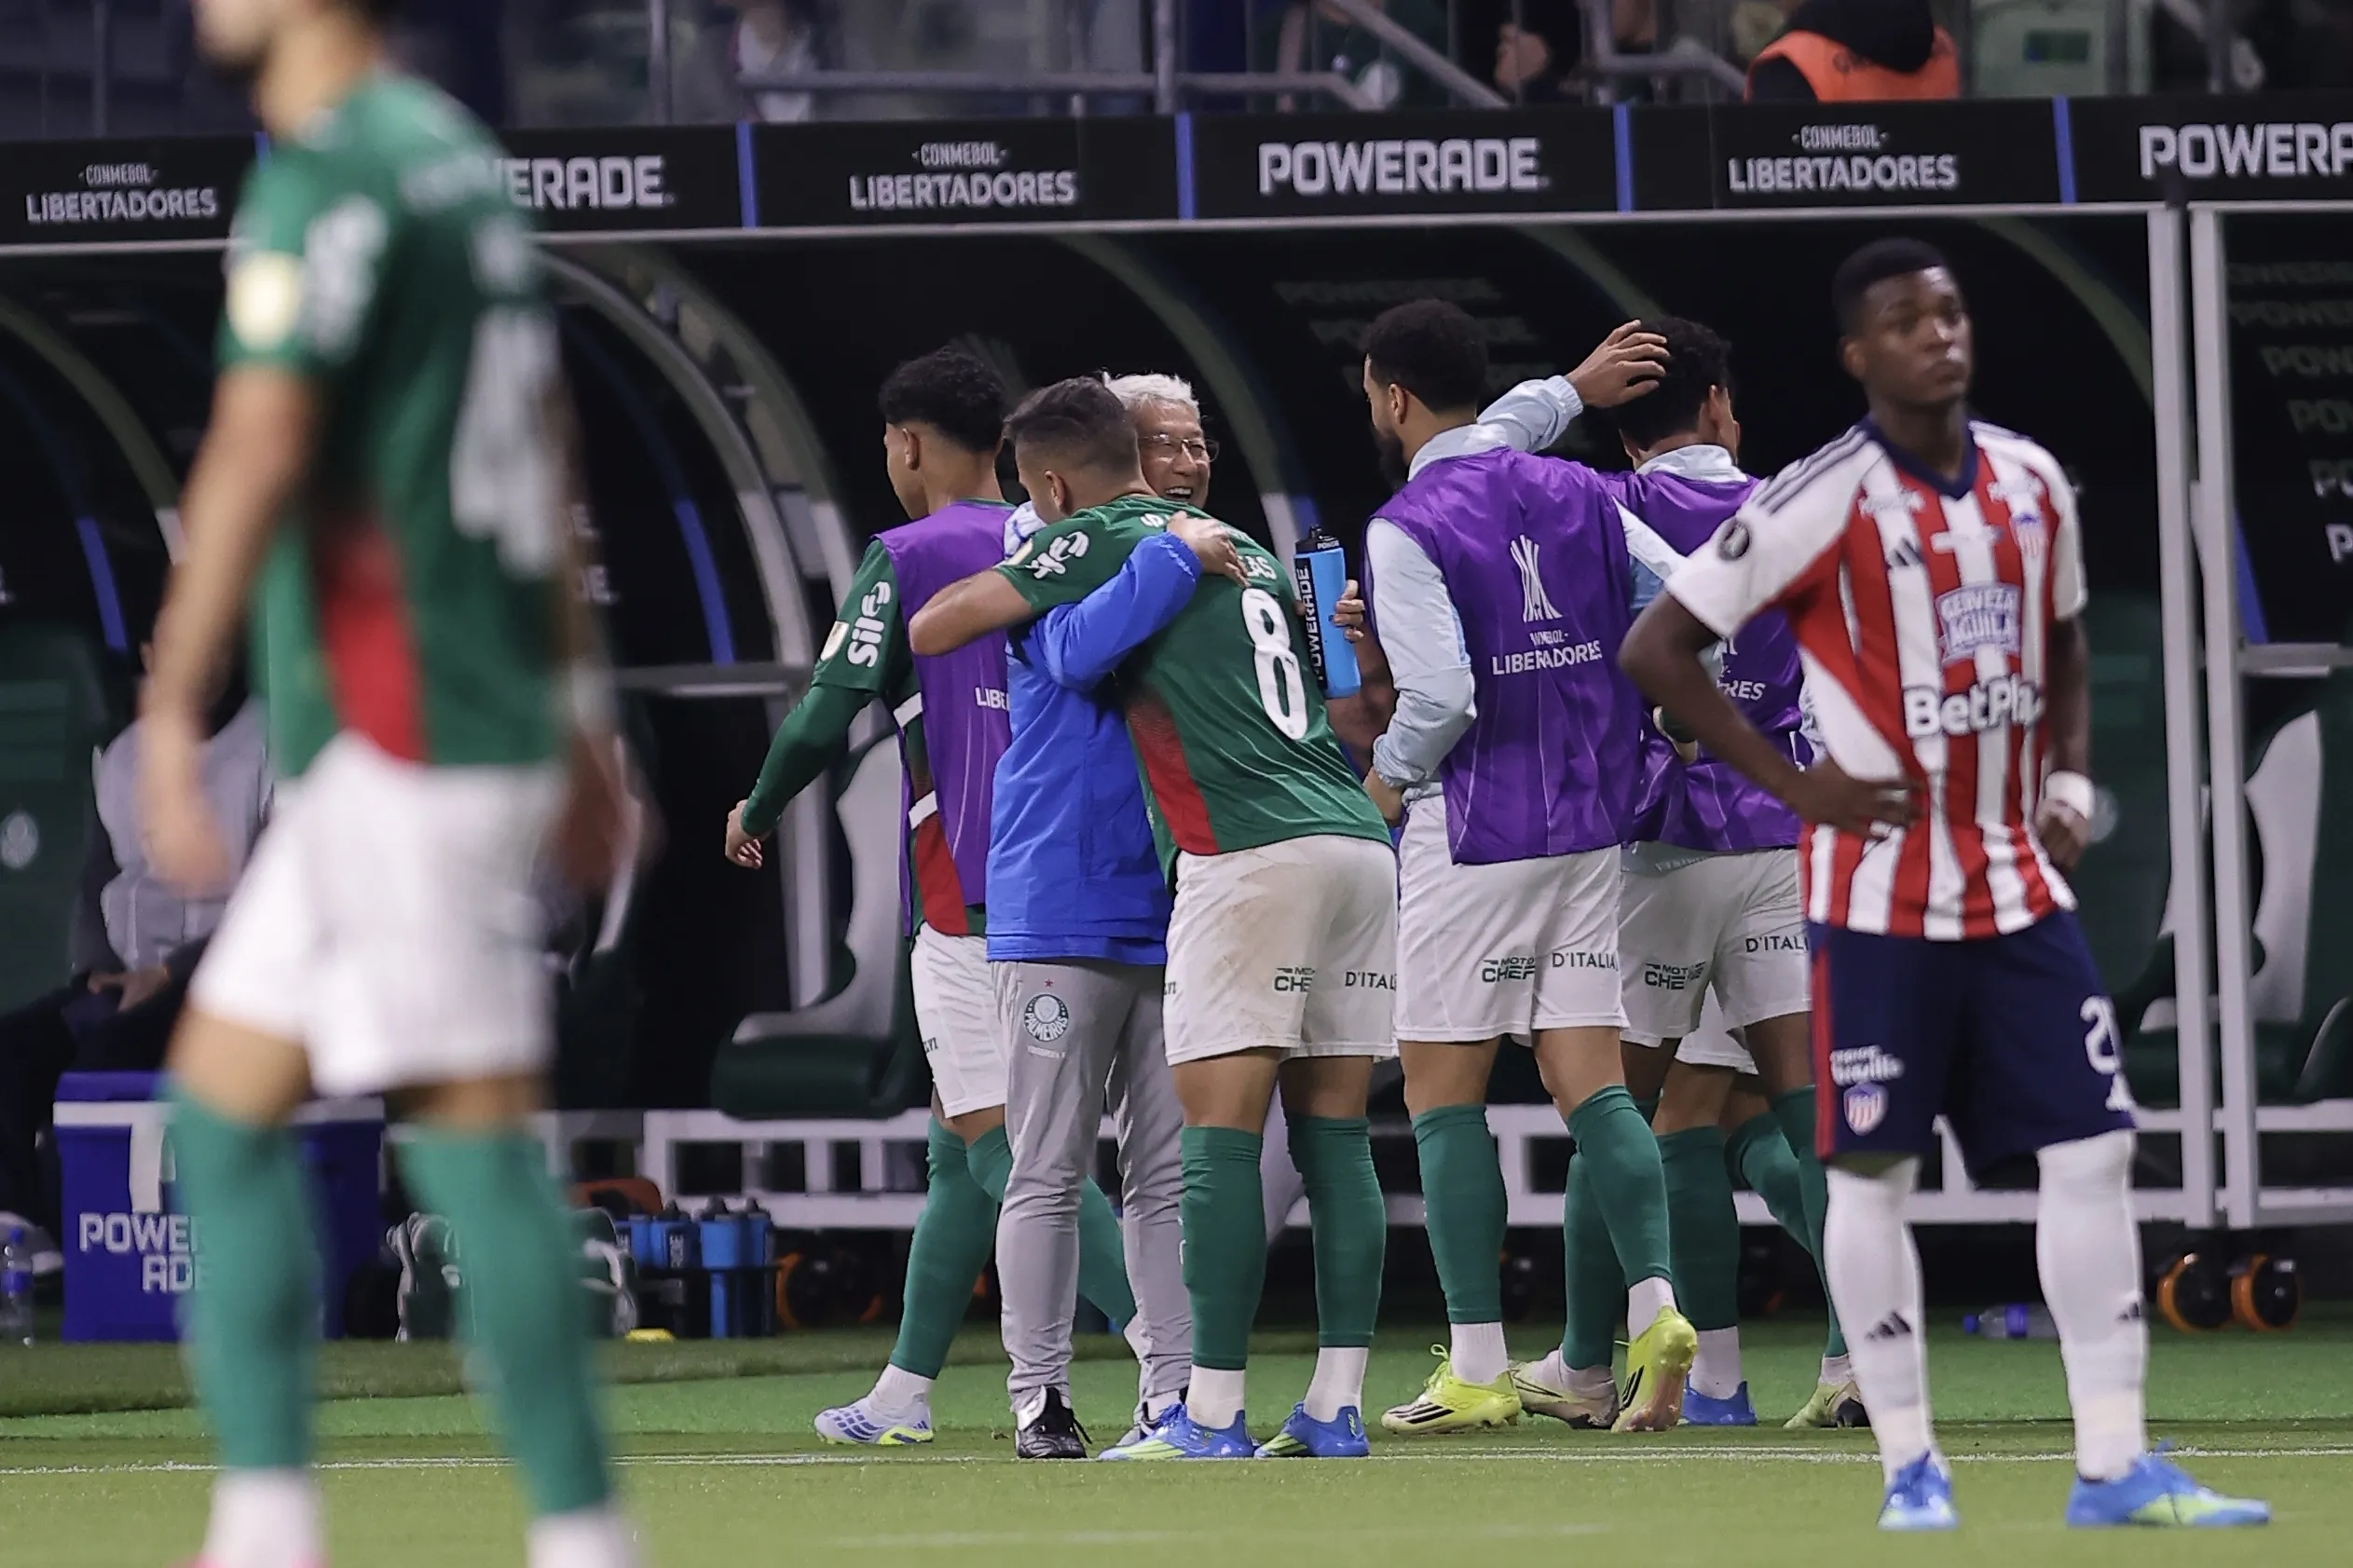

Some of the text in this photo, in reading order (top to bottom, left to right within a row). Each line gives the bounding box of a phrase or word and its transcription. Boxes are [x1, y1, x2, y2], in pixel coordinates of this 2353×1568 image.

[921, 142, 1001, 166] CONMEBOL
[1799, 125, 1881, 150] CONMEBOL
[2139, 122, 2353, 179] POWERA
[504, 156, 664, 209] ERADE
[1259, 138, 1539, 196] POWERADE
[1728, 155, 1958, 193] LIBERTADORES
[25, 188, 217, 223] LIBERTADORES
[849, 171, 1077, 210] LIBERTADORES
[1241, 587, 1308, 741] 8
[1745, 935, 1810, 953] D'ITALI
[1024, 1012, 1069, 1041] PALMEIRAS
[79, 1213, 198, 1252] POWE
